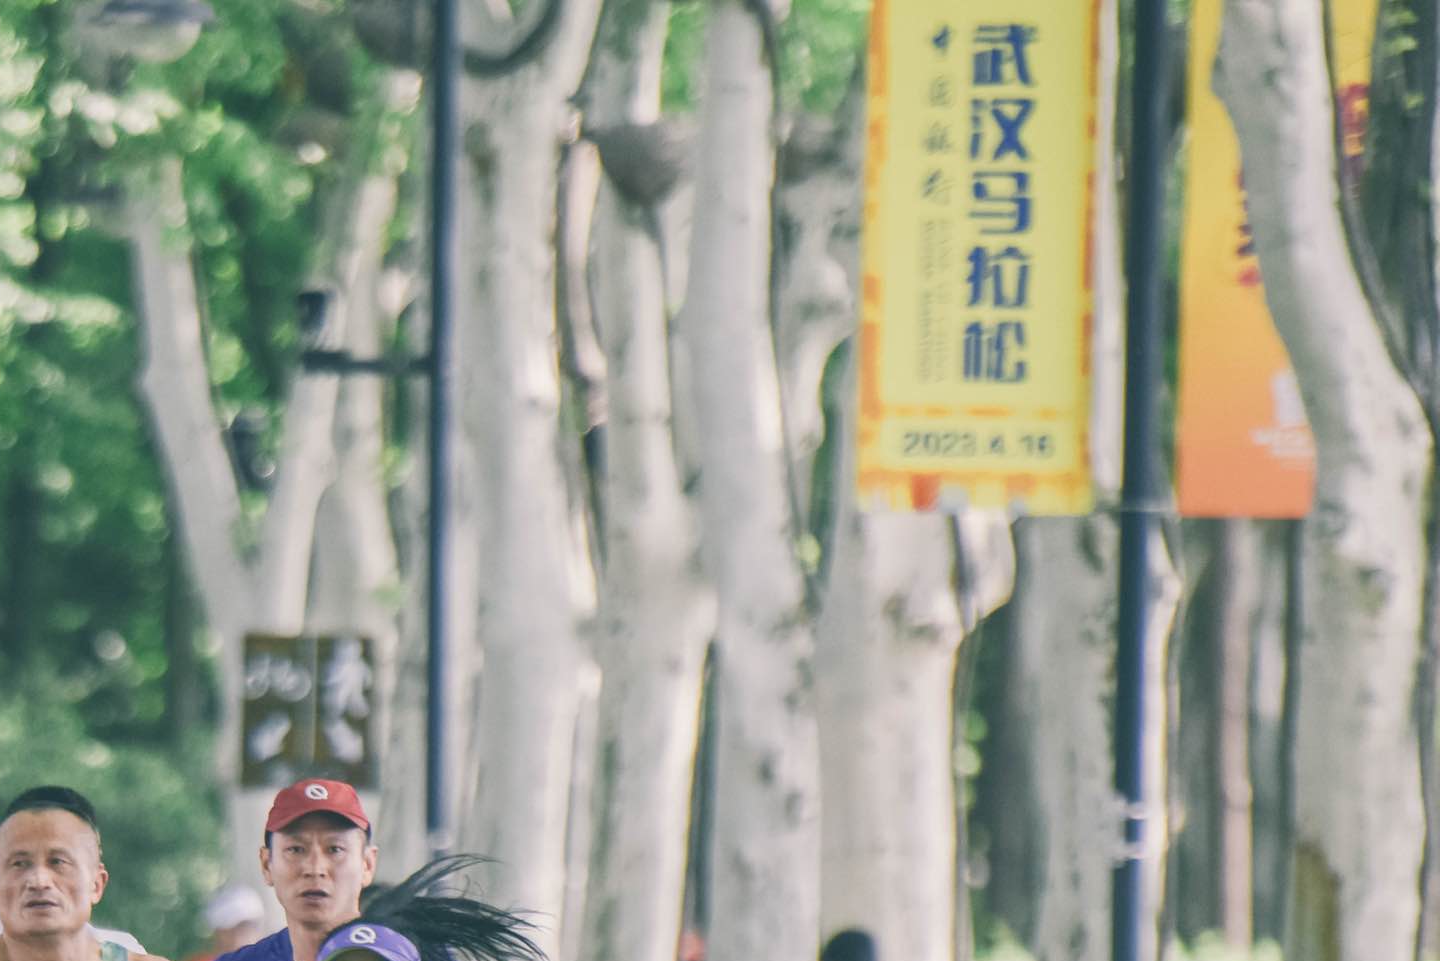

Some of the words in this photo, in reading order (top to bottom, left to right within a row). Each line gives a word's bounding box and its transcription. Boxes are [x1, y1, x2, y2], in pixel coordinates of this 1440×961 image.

[962, 23, 1038, 384] 武汉马拉松
